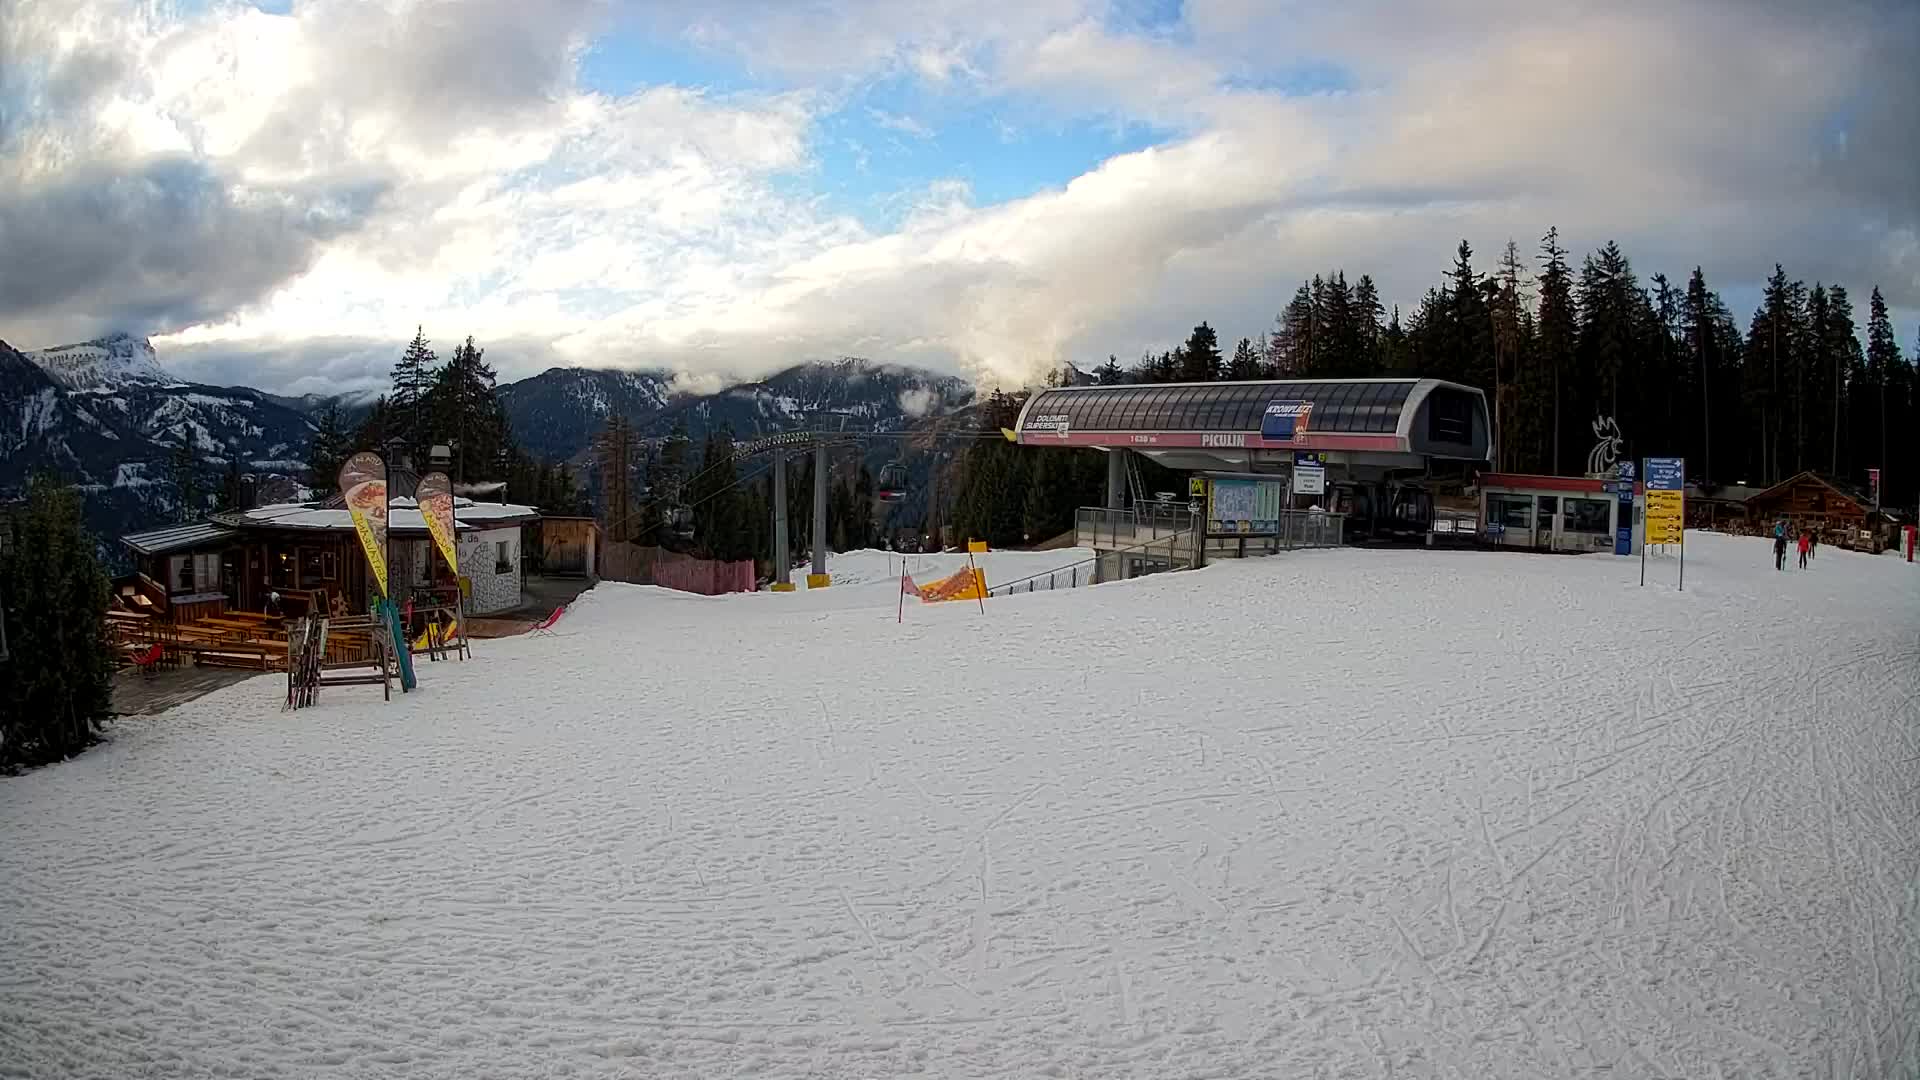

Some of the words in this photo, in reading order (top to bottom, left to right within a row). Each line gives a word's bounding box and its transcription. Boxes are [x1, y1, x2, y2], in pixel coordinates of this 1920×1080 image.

[1036, 414, 1069, 422] DOLOMITI
[1025, 422, 1059, 430] SUPERSKI
[1201, 434, 1245, 447] PICULIN
